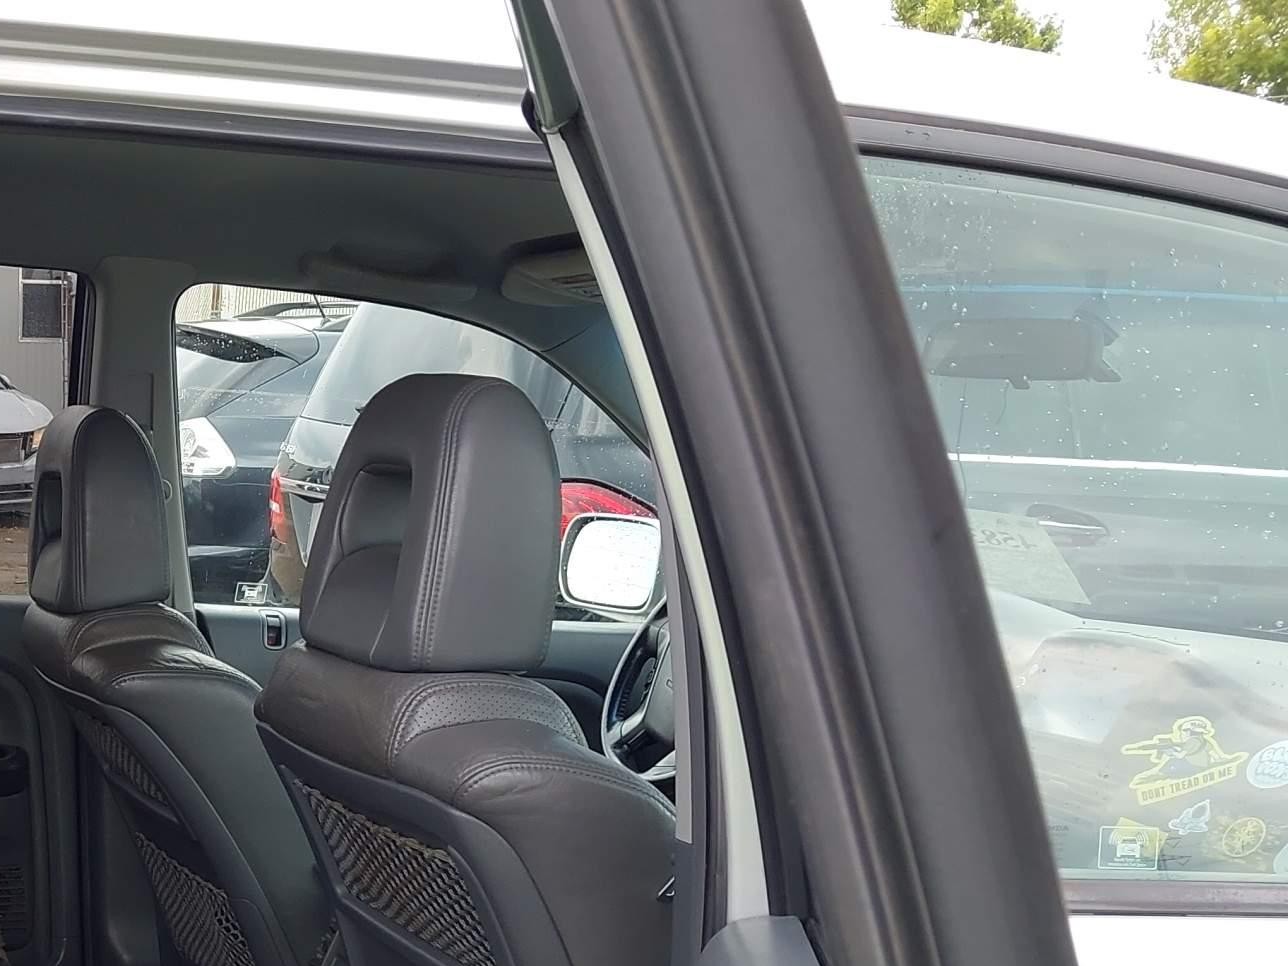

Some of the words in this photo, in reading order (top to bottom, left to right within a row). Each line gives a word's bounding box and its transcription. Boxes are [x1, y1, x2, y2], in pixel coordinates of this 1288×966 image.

[1141, 786, 1165, 801] DONT
[1169, 776, 1200, 794] TREAD
[1202, 771, 1215, 784] ON
[1218, 766, 1233, 779] ME
